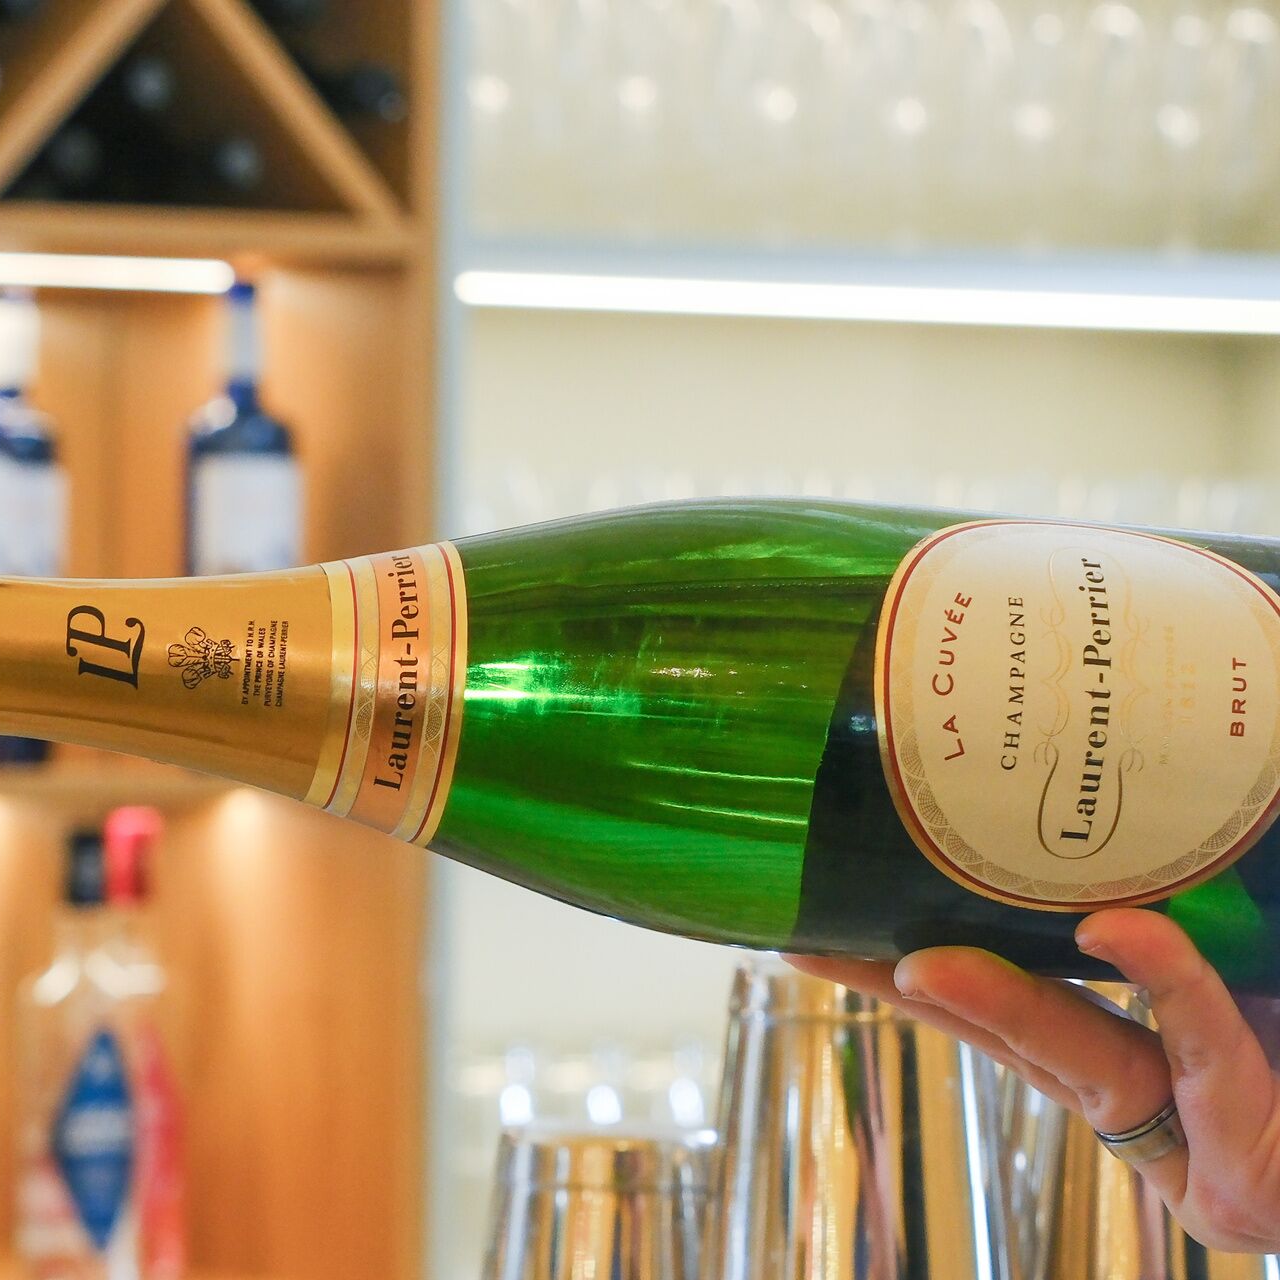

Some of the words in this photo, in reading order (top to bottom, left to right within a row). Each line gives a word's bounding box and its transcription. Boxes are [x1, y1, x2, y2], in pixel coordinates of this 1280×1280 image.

[246, 639, 254, 647] TO
[256, 650, 264, 658] OF
[258, 627, 266, 649] WALES
[268, 620, 278, 658] CHAMPAGNE
[278, 620, 289, 670] LAURENT-PERRIER
[931, 591, 973, 697] CUVÉE
[242, 648, 253, 695] APPOINTMENT
[255, 660, 263, 683] PRINCE
[267, 659, 274, 668] OF
[372, 552, 420, 792] Laurent-Perrier
[253, 684, 261, 696] THE
[264, 669, 274, 707] PURVEYORS
[275, 670, 285, 707] CHAMPAGNE
[1000, 595, 1027, 771] CHAMPAGNE
[1058, 556, 1113, 843] Laurent-Perrier
[1229, 657, 1247, 737] BRUT
[944, 714, 966, 761] LA
